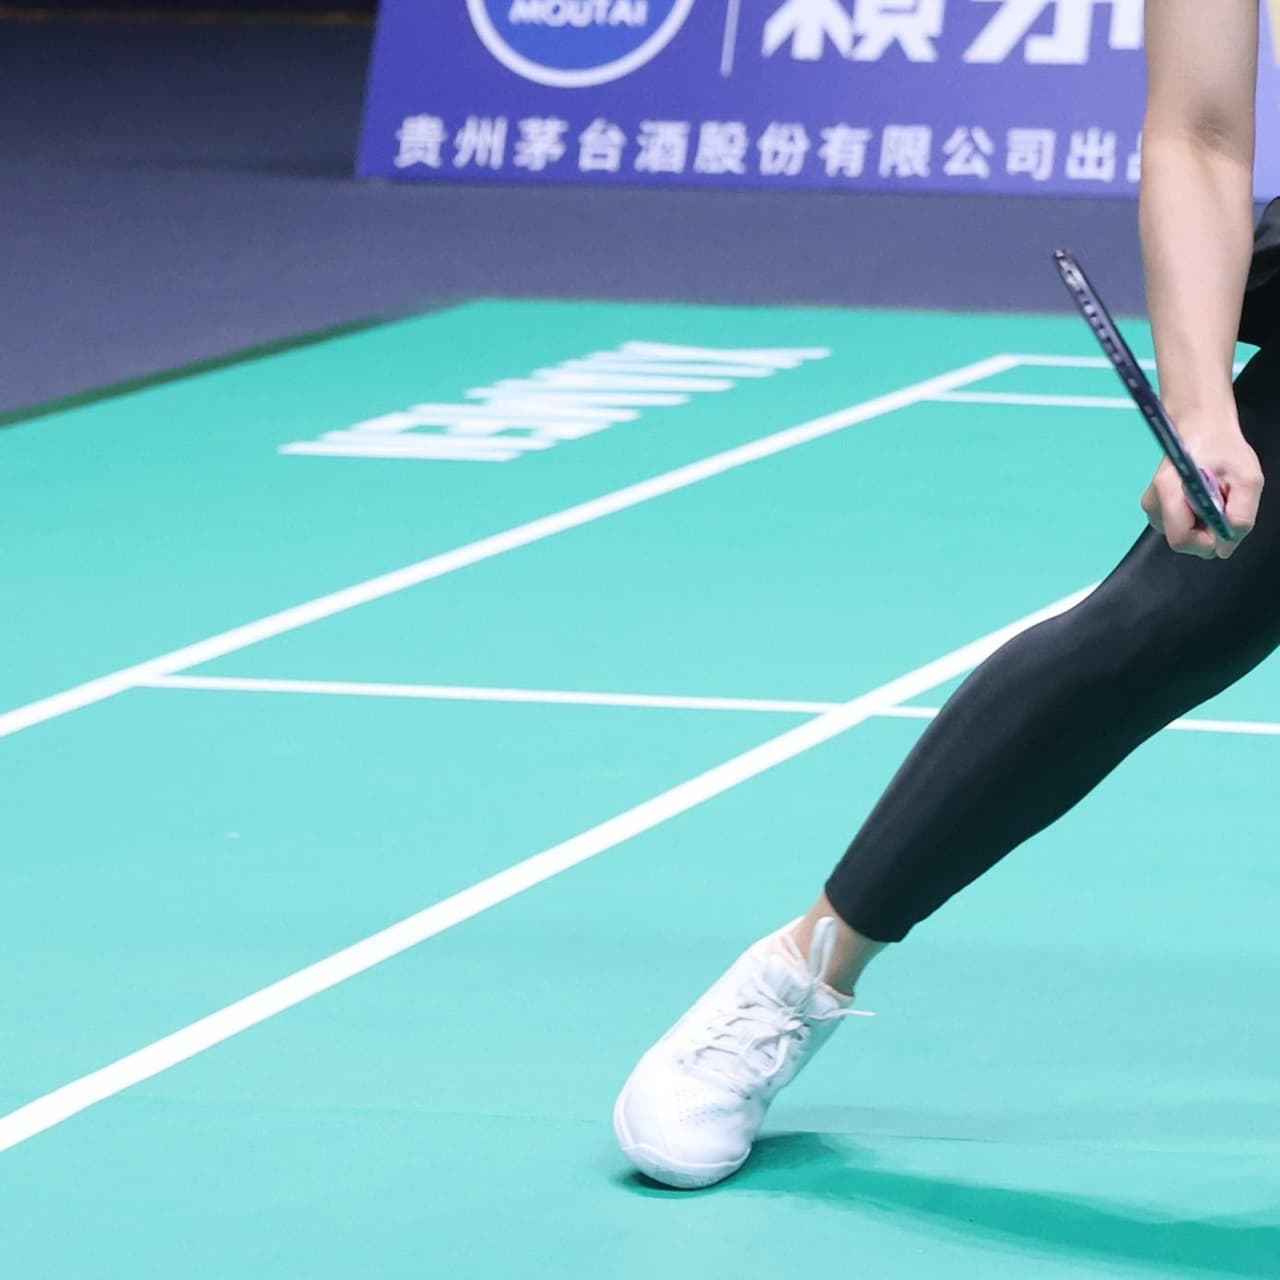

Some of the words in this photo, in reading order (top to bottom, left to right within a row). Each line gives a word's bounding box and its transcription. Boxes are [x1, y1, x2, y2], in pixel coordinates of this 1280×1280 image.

[395, 114, 1142, 183] 贵州茅台酒股份有限公司出
